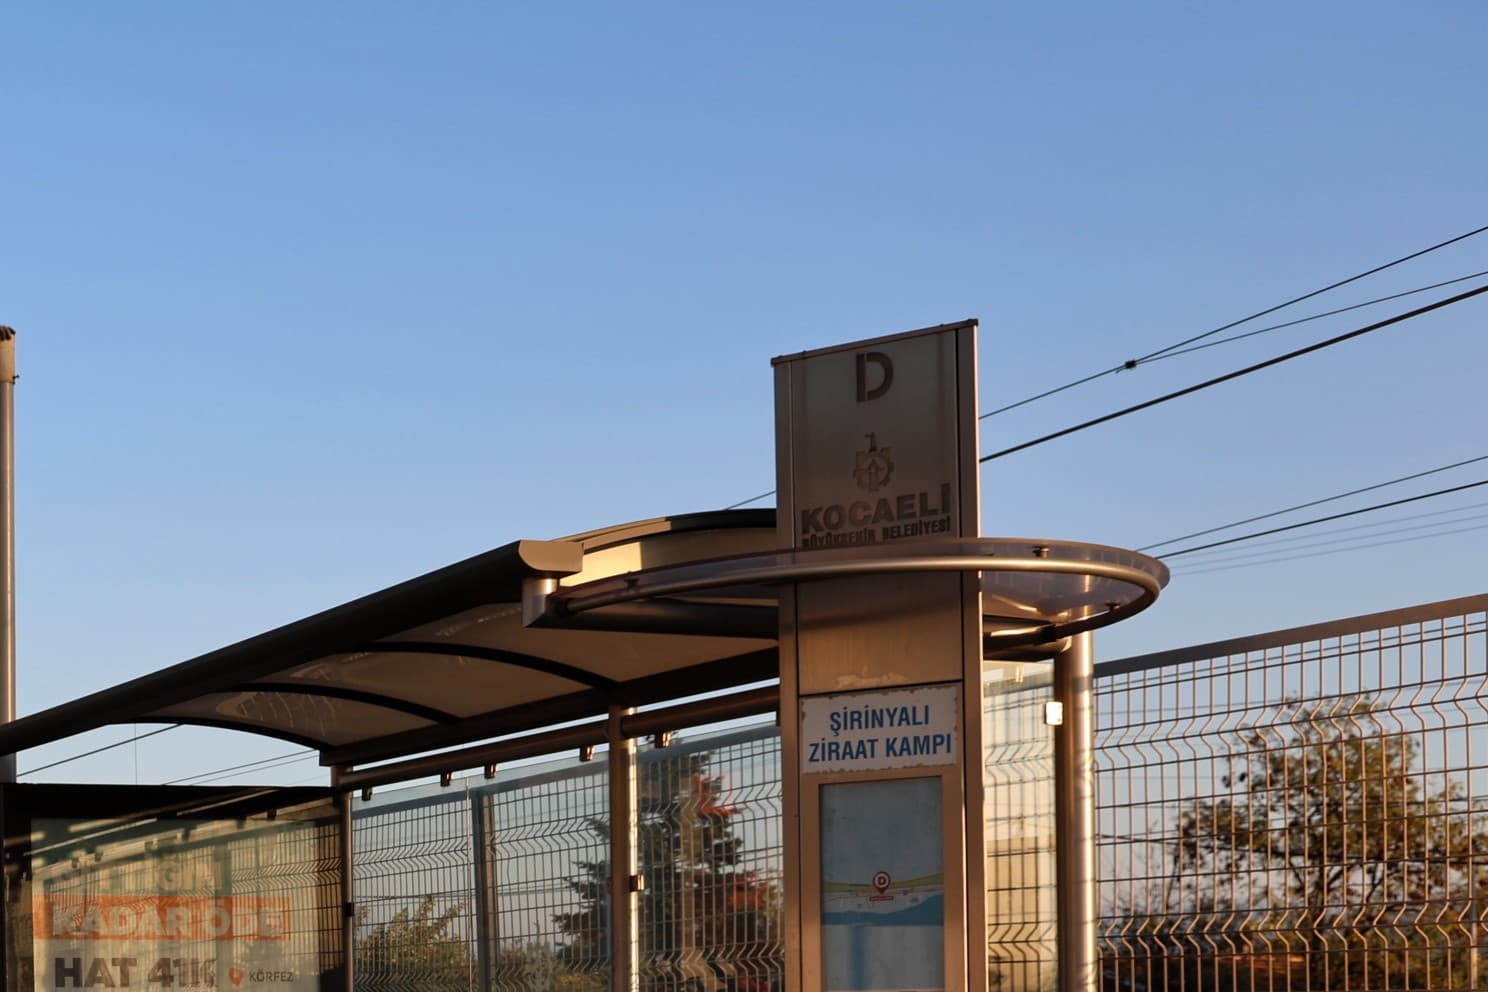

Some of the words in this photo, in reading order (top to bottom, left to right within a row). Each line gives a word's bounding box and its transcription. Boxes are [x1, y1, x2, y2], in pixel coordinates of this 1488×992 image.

[855, 351, 894, 403] D
[829, 704, 930, 734] ŞİRİNYALI
[809, 738, 878, 763] ZİRAAT
[885, 732, 952, 758] KAMPI
[52, 903, 192, 937] KADAR
[204, 899, 283, 937] ÖDE
[54, 957, 137, 988] HAT
[249, 965, 294, 983] KÖRFEZ
